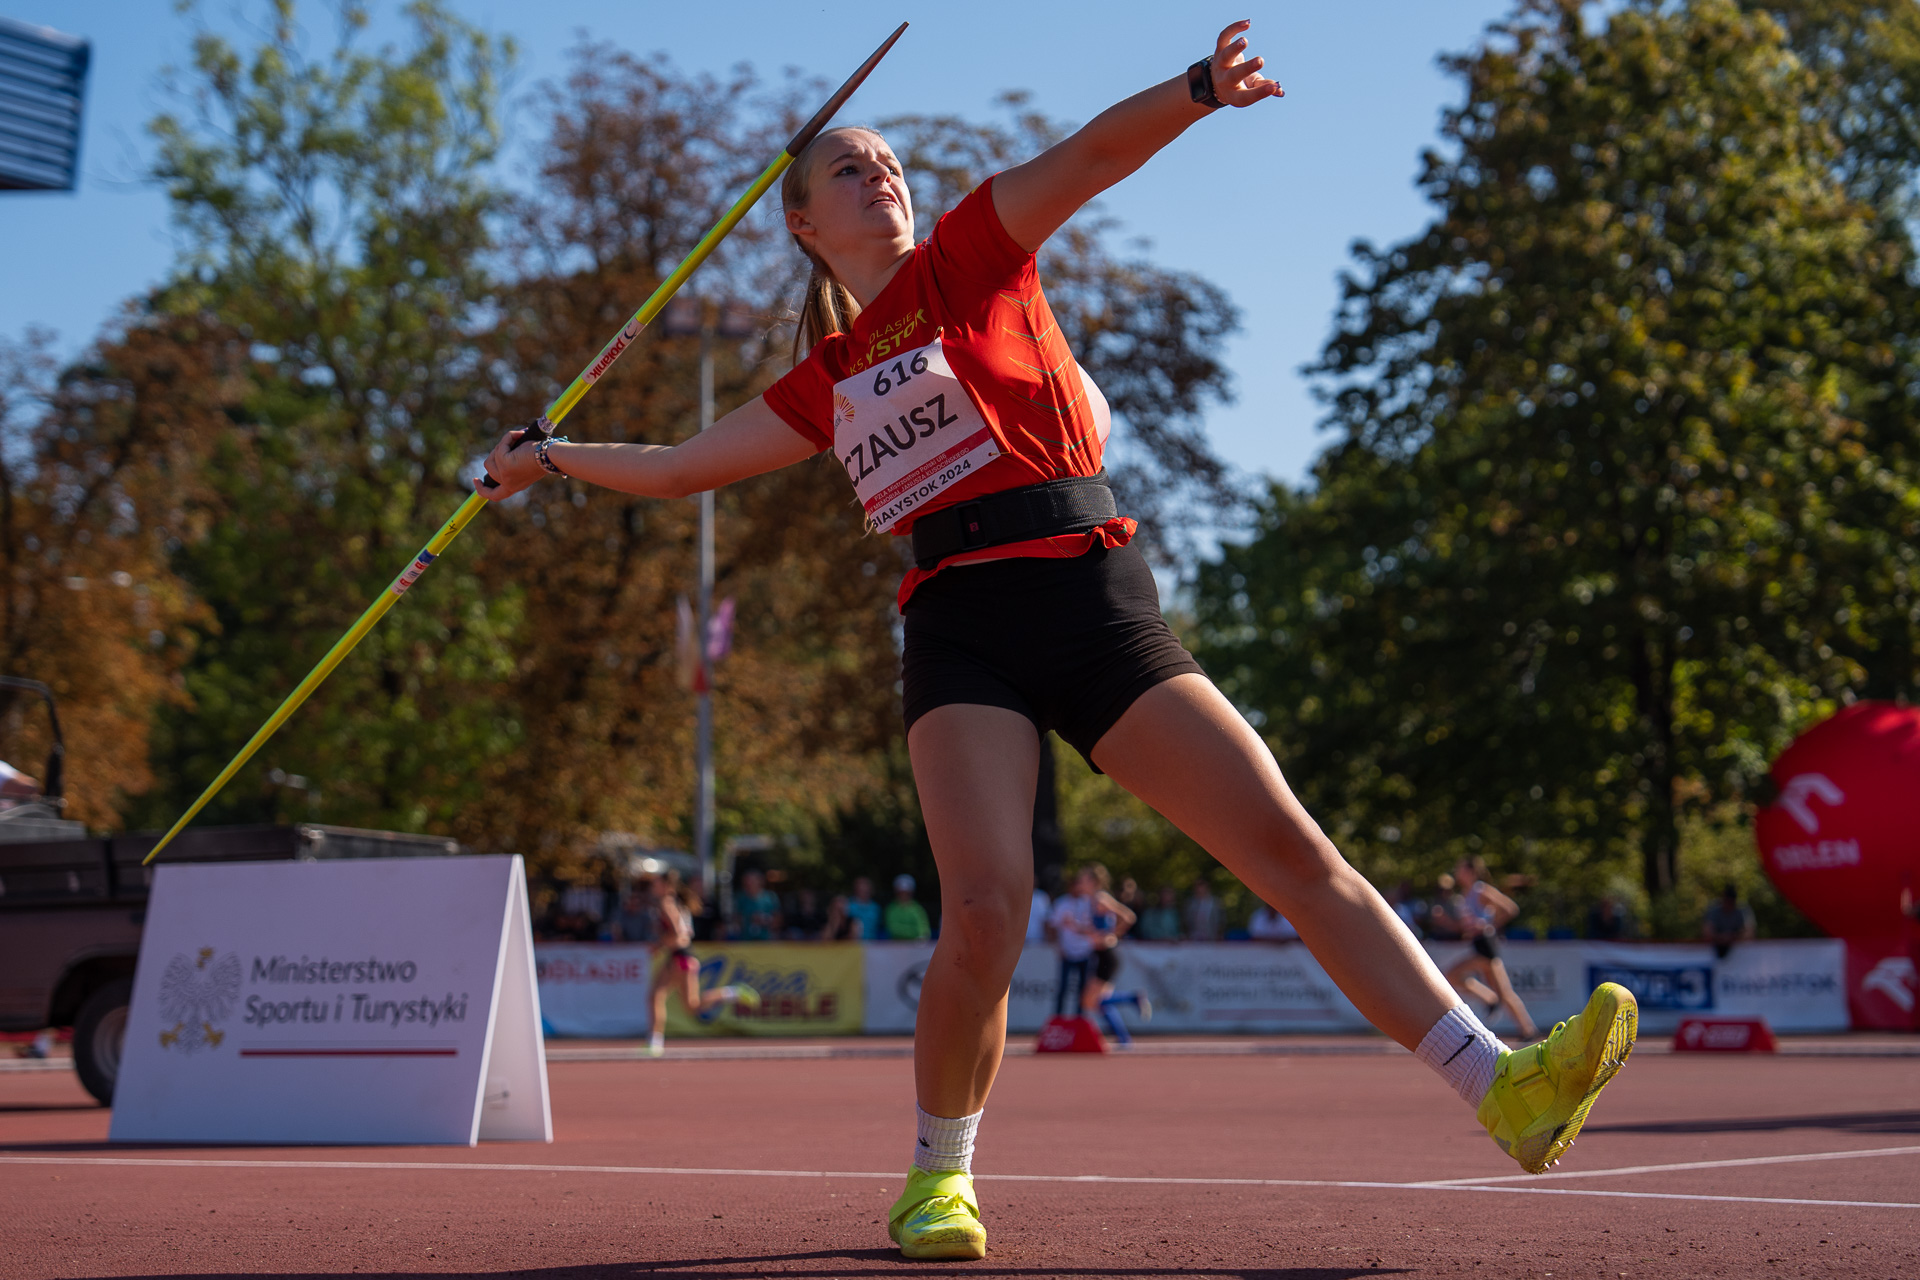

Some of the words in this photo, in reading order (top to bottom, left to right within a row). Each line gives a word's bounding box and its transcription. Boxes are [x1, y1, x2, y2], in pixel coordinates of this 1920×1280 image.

[589, 337, 626, 380] polanik
[873, 350, 929, 397] 616
[887, 470, 921, 493] Mistrzostwa
[920, 460, 937, 473] Polski
[939, 459, 972, 486] 2024
[873, 491, 901, 509] MEMORIAŁ
[901, 475, 927, 493] JANUSZA
[250, 955, 418, 984] Ministerstwo
[243, 994, 328, 1029] Sportu
[333, 994, 343, 1023] i
[350, 993, 469, 1029] Turystyki
